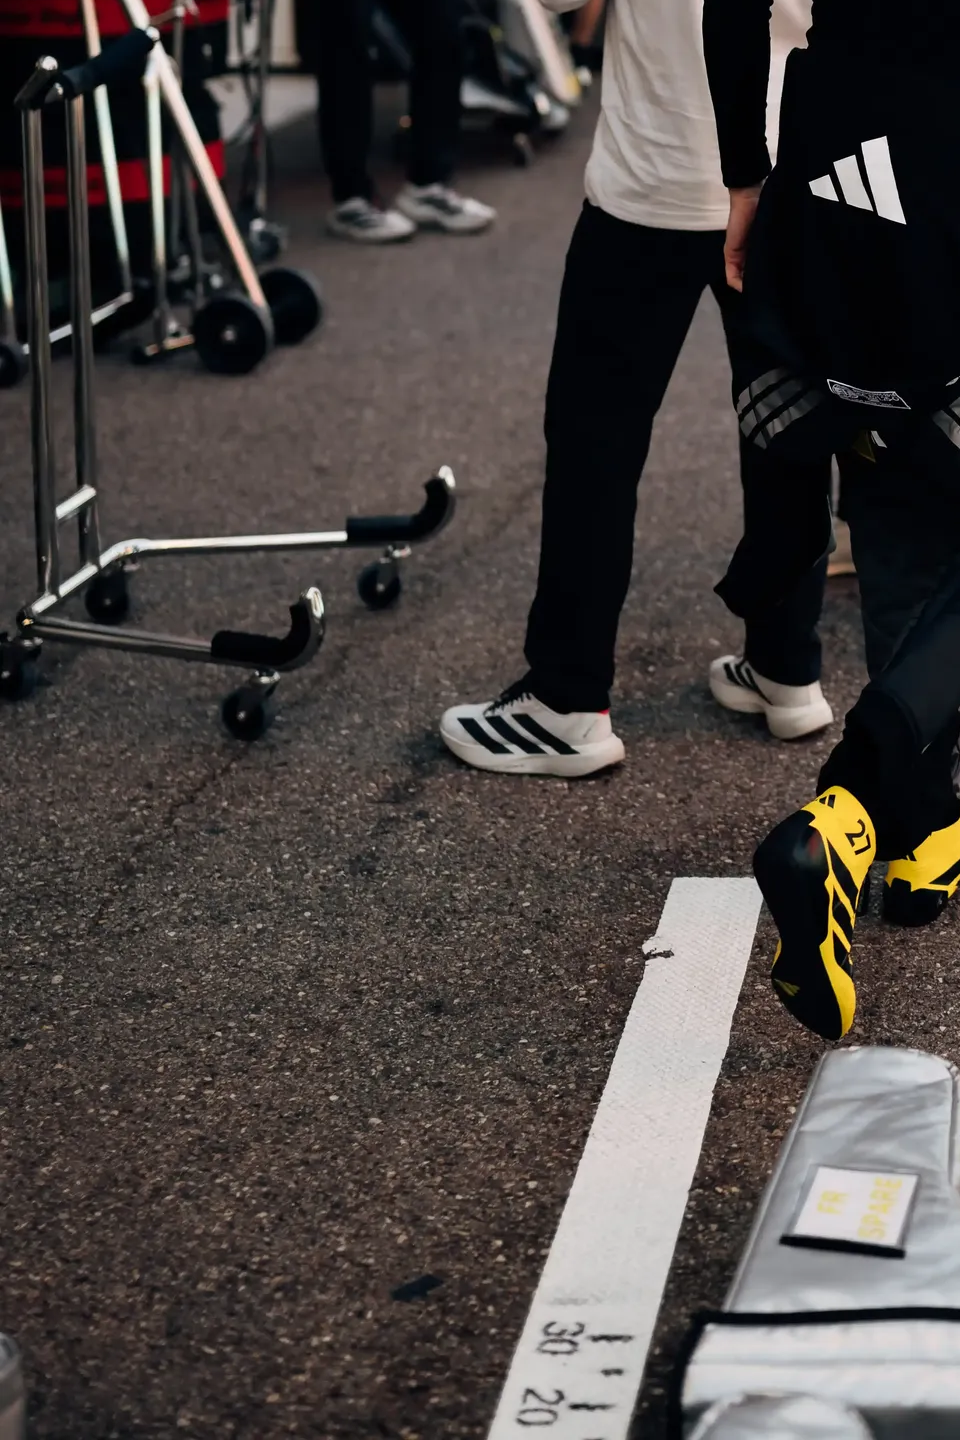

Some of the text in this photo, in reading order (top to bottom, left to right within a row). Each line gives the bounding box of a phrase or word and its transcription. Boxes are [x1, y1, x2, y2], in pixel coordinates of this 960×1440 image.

[844, 818, 872, 856] 27
[816, 1189, 850, 1216] FR
[856, 1175, 904, 1241] SPARE
[536, 1320, 586, 1357] 30
[515, 1387, 566, 1427] 20
